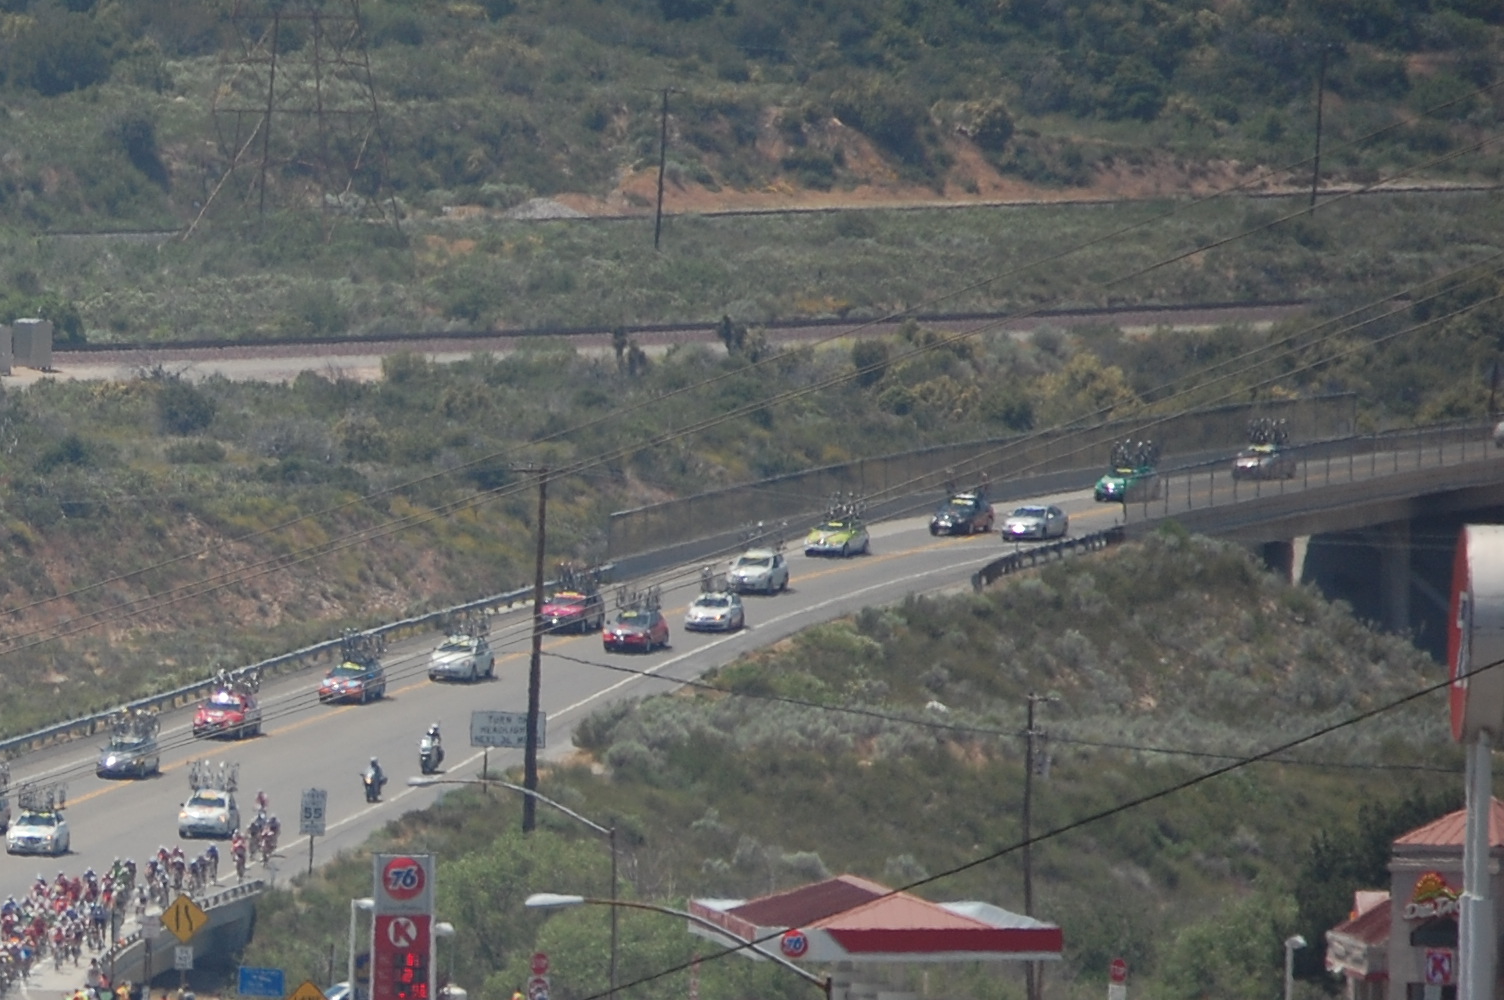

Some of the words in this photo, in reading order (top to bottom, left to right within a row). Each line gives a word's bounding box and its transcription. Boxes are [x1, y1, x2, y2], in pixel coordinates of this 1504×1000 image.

[304, 807, 322, 819] 55
[389, 866, 418, 890] 76
[784, 936, 804, 952] 76
